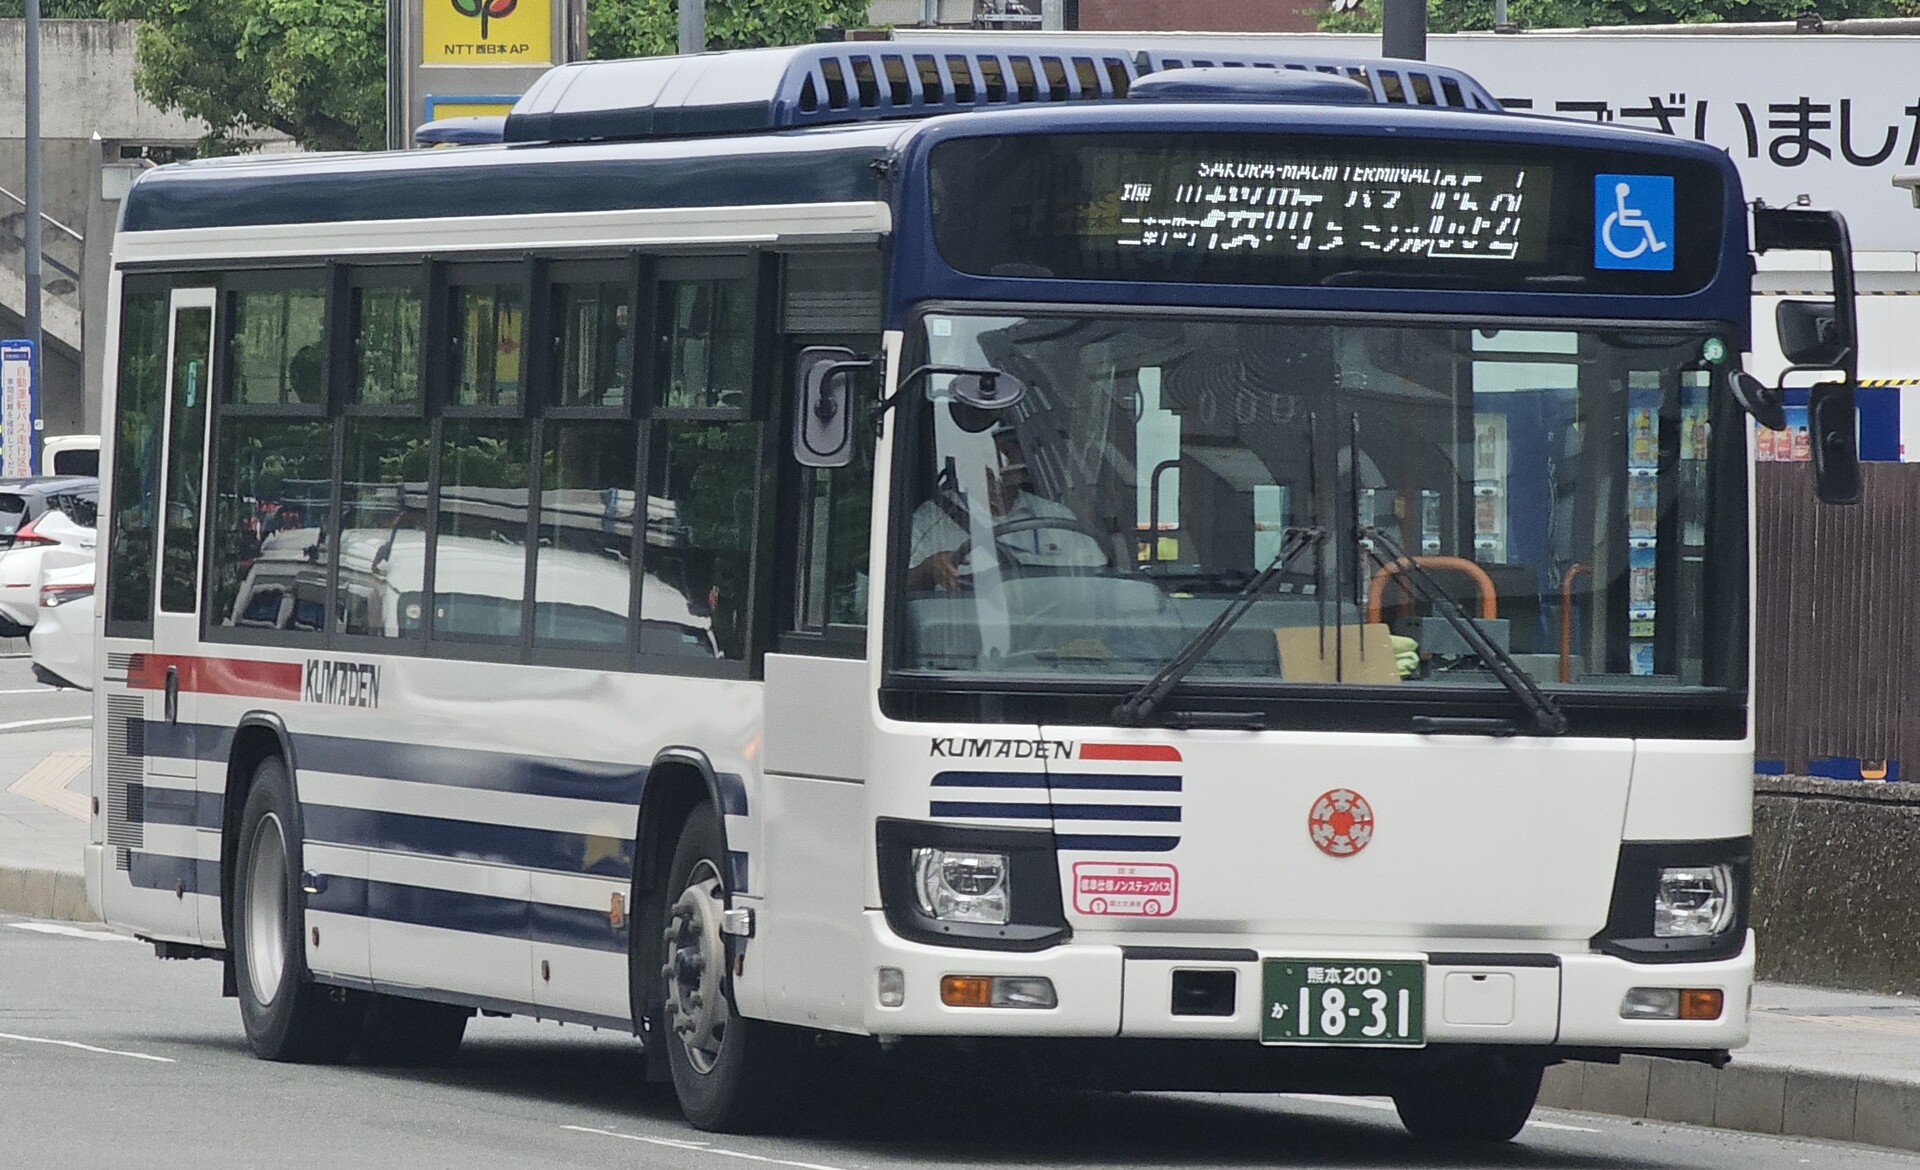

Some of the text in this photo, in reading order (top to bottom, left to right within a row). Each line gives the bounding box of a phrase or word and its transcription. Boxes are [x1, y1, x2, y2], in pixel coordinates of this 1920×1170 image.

[305, 659, 381, 709] KUMADEN
[930, 738, 1073, 760] KUMADEN
[1271, 987, 1409, 1037] か 18-31
